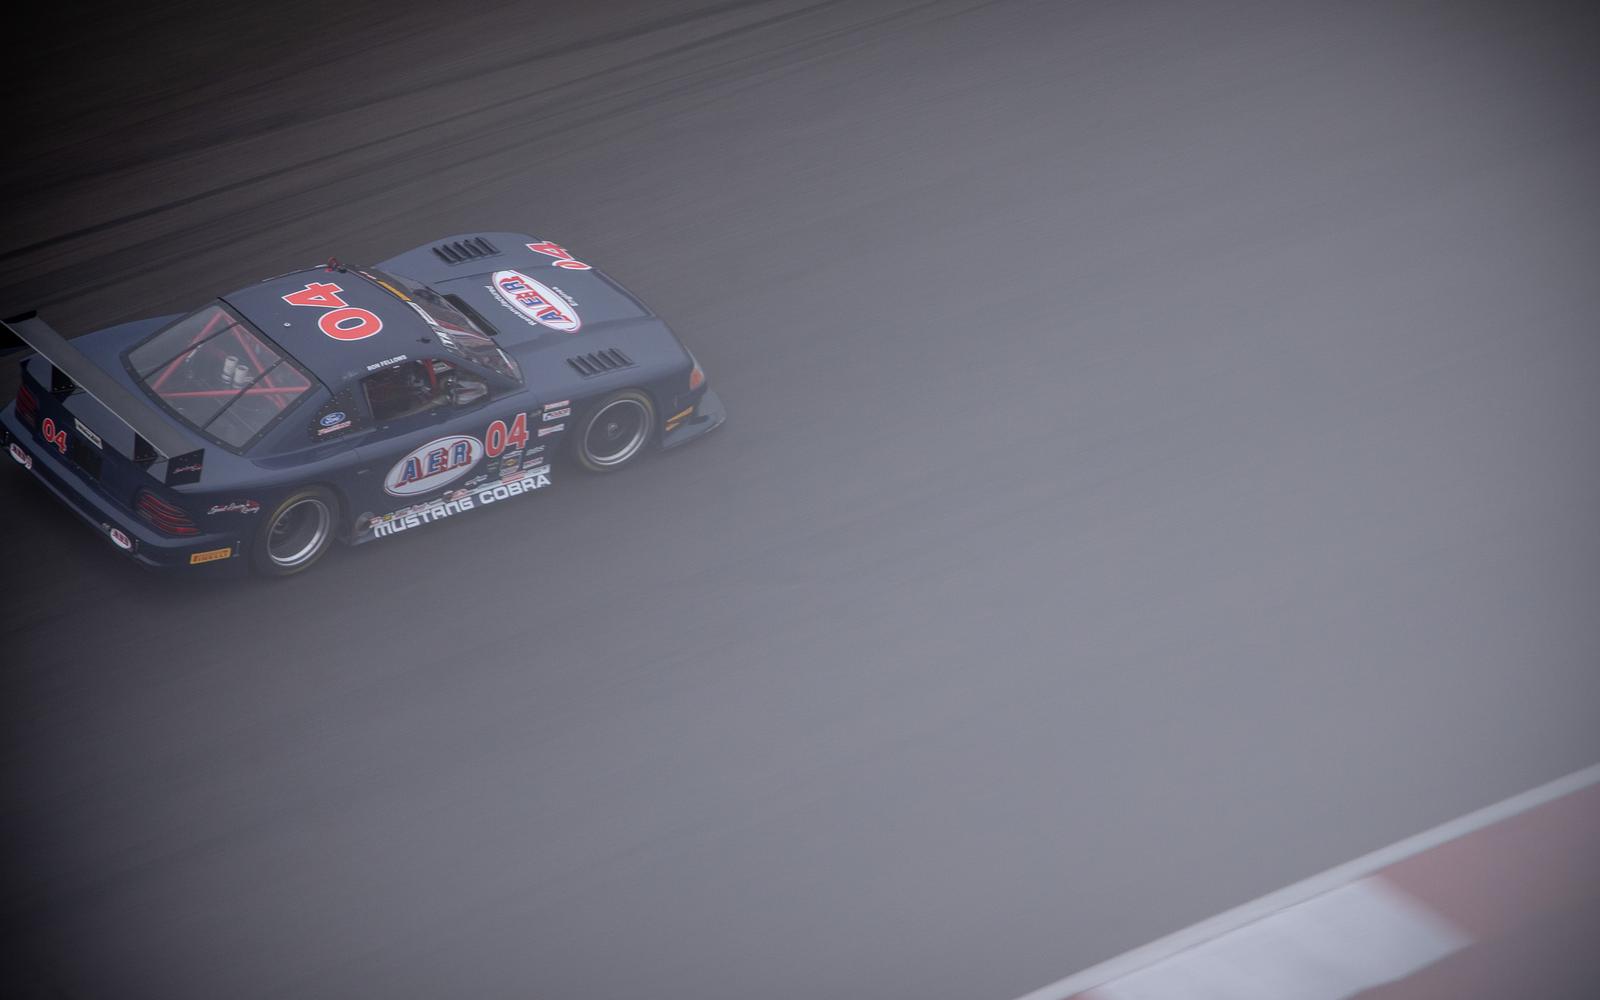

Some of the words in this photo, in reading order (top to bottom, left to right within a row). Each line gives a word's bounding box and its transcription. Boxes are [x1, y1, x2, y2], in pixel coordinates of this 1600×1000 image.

[524, 240, 593, 271] 04
[281, 281, 384, 342] 04
[500, 275, 573, 323] AER
[41, 417, 68, 455] 04
[484, 411, 530, 458] 04
[394, 439, 473, 488] AER
[373, 495, 475, 538] MUSTANG
[478, 473, 552, 505] COBRA
